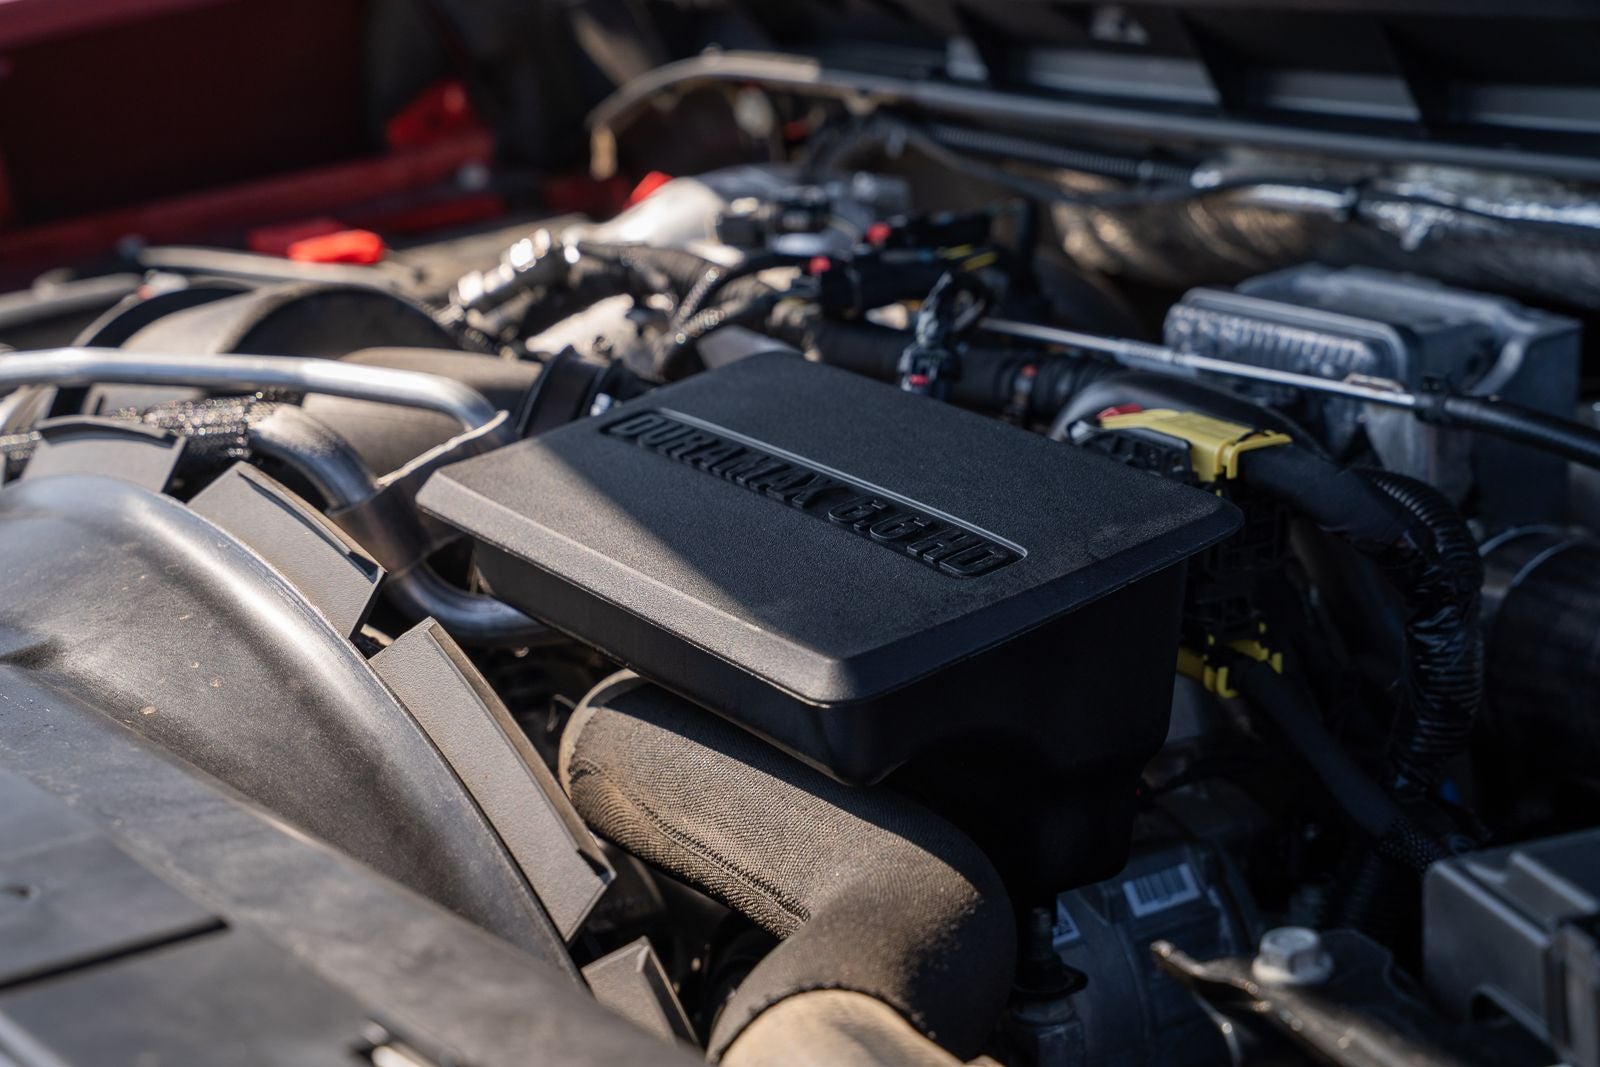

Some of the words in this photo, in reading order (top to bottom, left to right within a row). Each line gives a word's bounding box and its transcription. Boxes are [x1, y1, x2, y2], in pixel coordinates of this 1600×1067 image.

[608, 413, 840, 508] DURAMAX
[828, 495, 928, 543] 6.6
[907, 526, 1010, 576] HD
